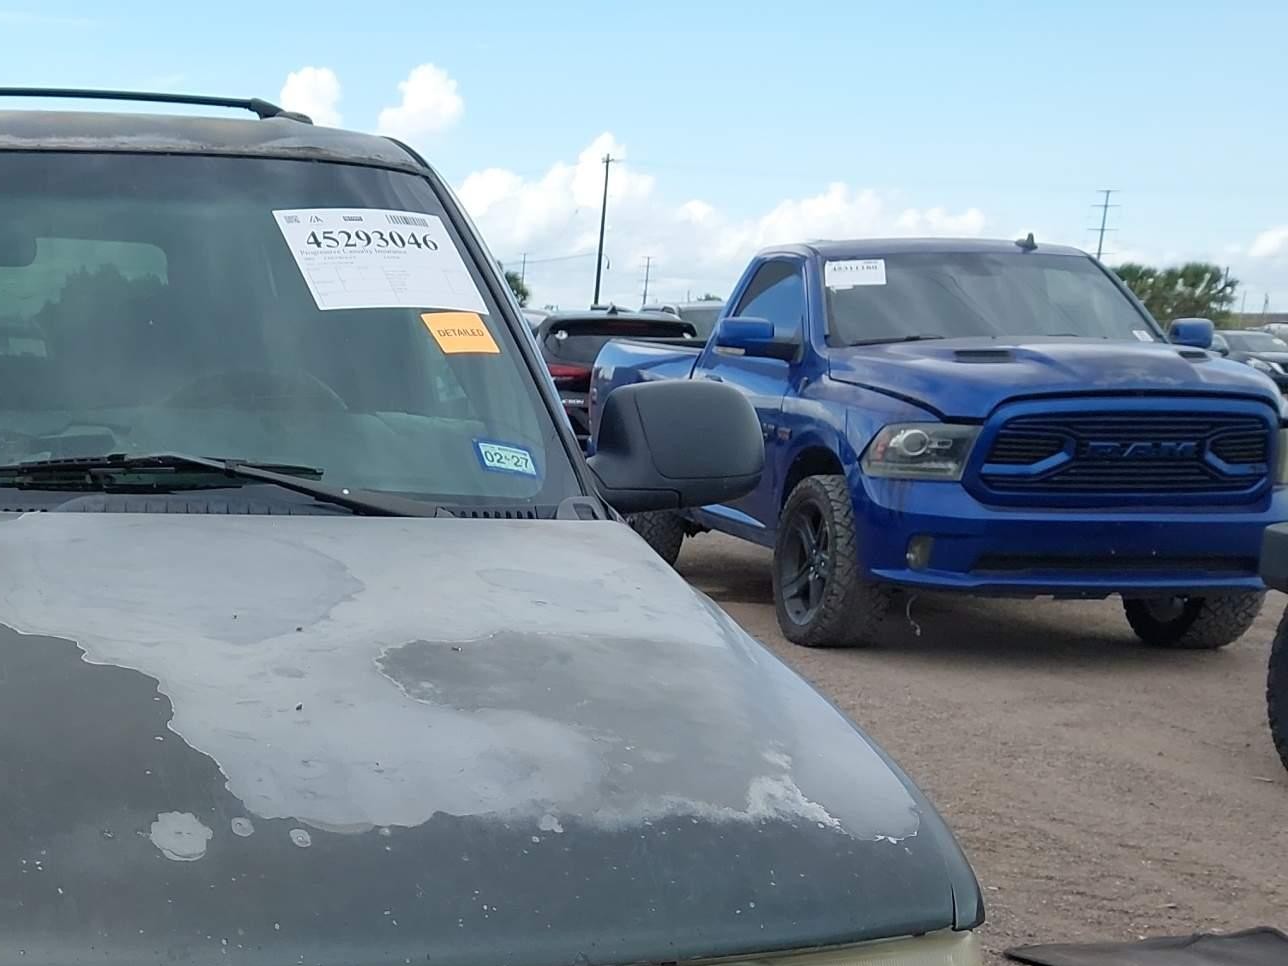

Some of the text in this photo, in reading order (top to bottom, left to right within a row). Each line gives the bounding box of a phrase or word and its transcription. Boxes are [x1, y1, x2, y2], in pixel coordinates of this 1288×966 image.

[306, 230, 439, 251] 45293046
[437, 328, 485, 337] DETAILED
[1088, 441, 1197, 458] RAM
